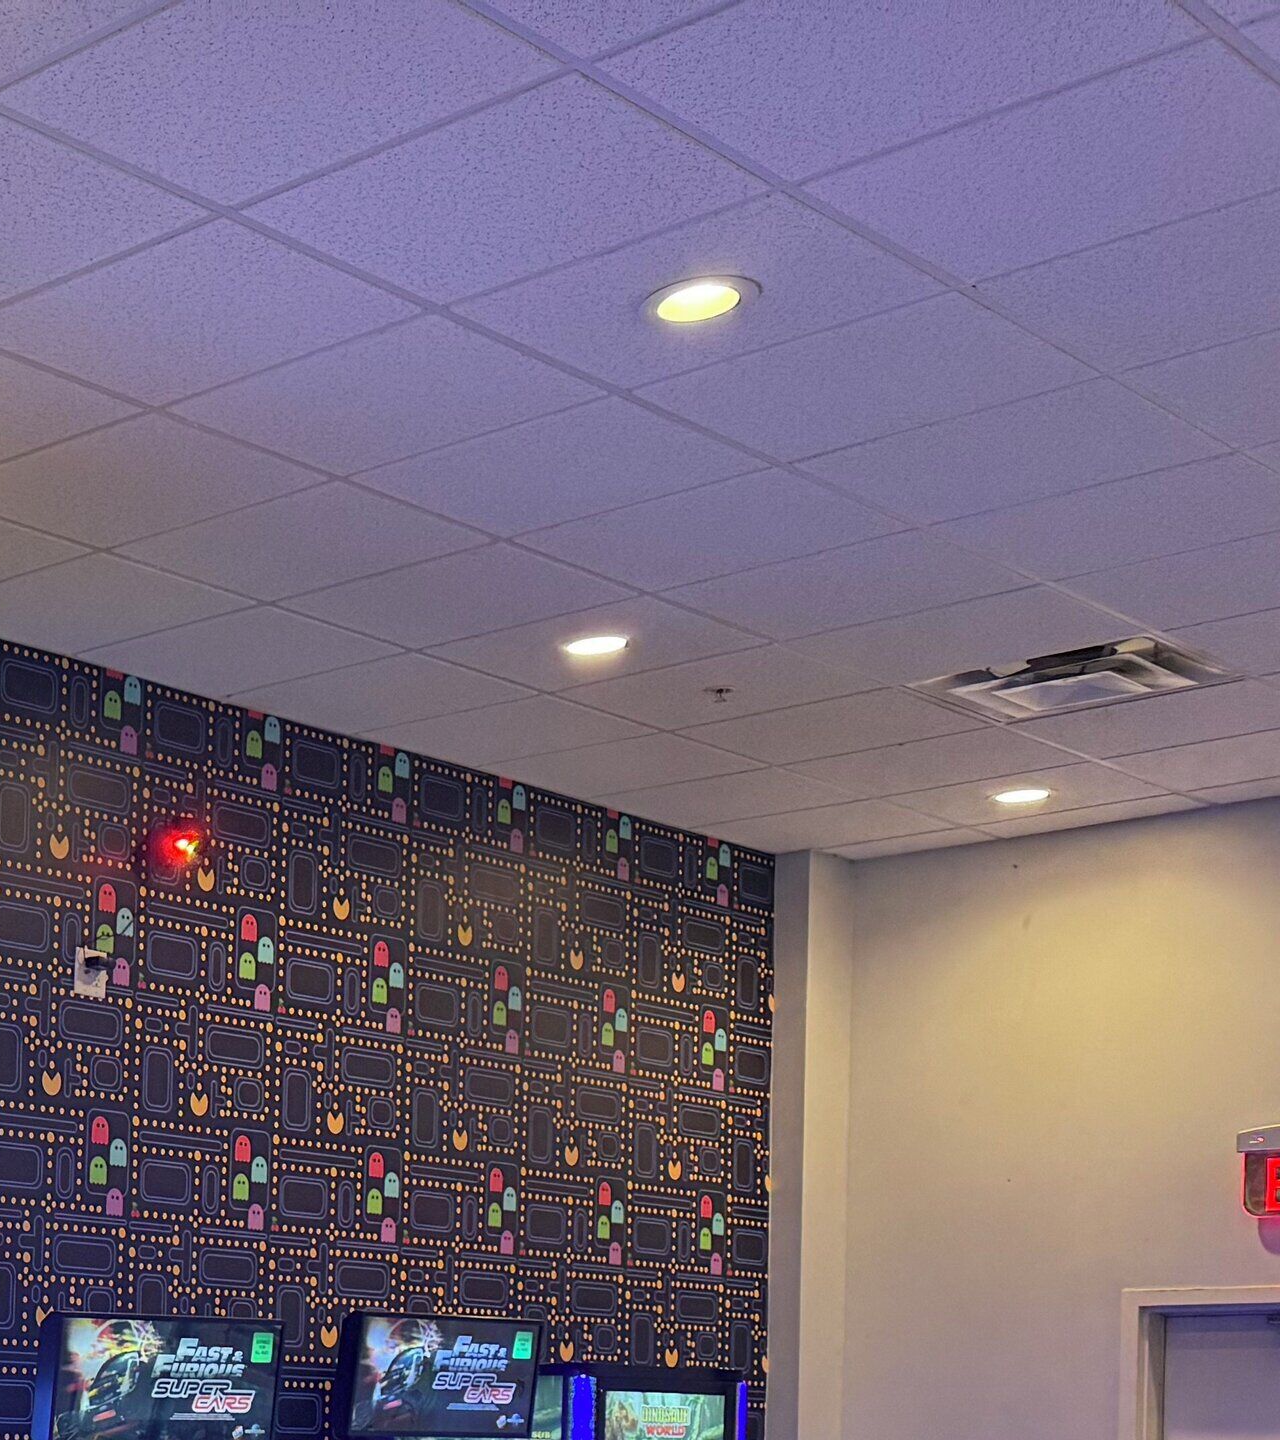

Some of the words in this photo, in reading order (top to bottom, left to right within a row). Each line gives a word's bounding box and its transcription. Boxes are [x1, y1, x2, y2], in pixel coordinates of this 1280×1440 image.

[175, 1338, 233, 1362] FAST
[232, 1351, 243, 1362] &
[452, 1335, 499, 1359] FAST
[151, 1354, 245, 1378] FURIOUS
[432, 1350, 508, 1371] FURIOUS
[151, 1378, 232, 1399] SUPER
[432, 1371, 497, 1390] SUPER
[192, 1394, 252, 1413] CARS
[464, 1386, 514, 1404] CARS
[642, 1406, 689, 1424] DINOSAUR
[645, 1425, 686, 1437] WORLD
